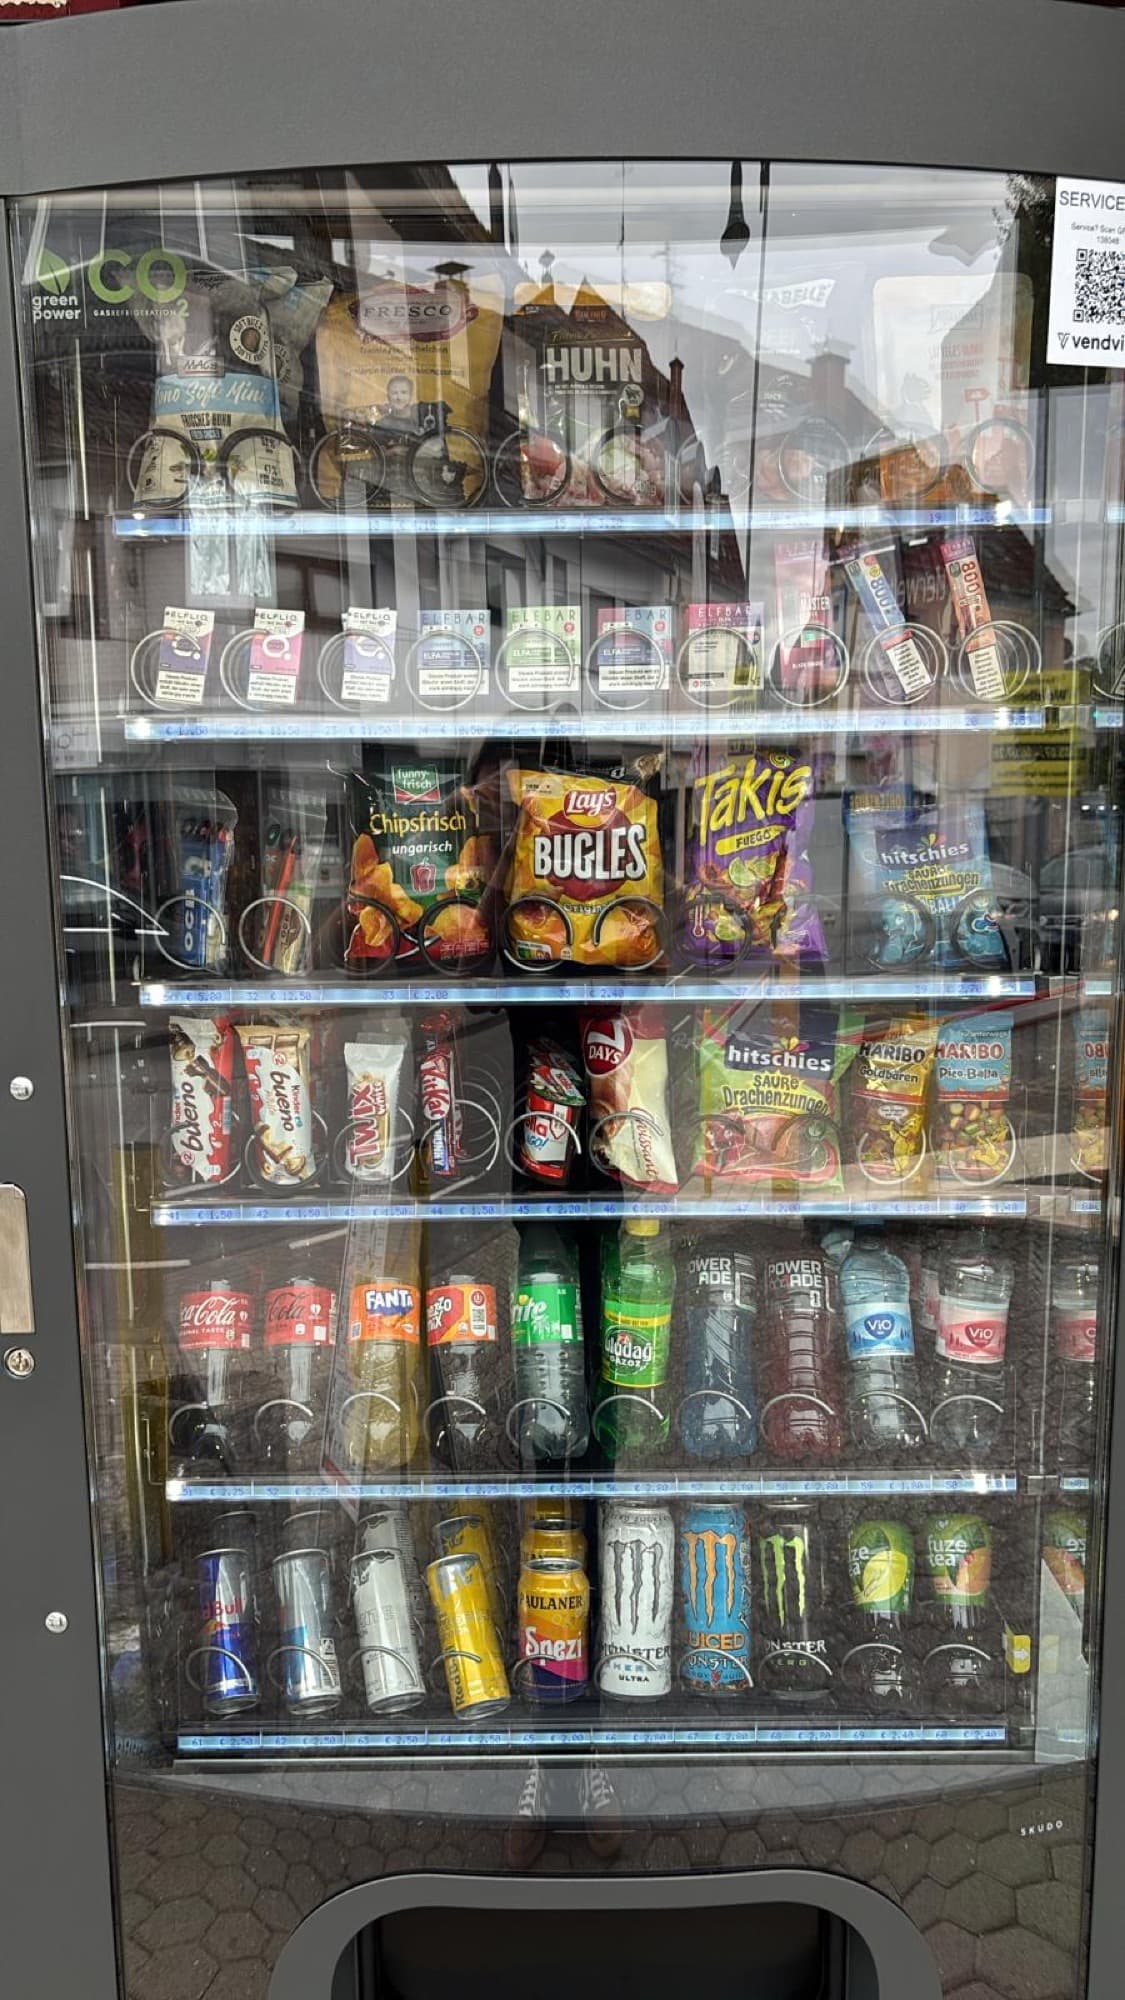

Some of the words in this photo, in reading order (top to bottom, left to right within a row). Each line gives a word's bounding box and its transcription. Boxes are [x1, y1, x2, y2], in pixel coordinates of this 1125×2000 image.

[1059, 190, 1125, 211] SERVICE
[32, 296, 78, 310] green
[364, 305, 451, 317] FRESCO
[33, 309, 81, 323] power
[547, 347, 642, 382] HUHN
[566, 788, 616, 817] Lay's
[695, 759, 812, 847] Takis
[369, 810, 467, 837] Chipsfrisch
[392, 840, 453, 857] ungarisch
[735, 829, 771, 849] FUEGO
[534, 824, 646, 880] BUGLES
[881, 842, 970, 865] hitschies
[588, 1044, 623, 1065] DAYS
[728, 1045, 832, 1072] hitschies
[859, 1041, 926, 1063] HARIBO
[934, 1043, 1004, 1059] HARIBO
[270, 1070, 295, 1132] bueno
[723, 1085, 829, 1115] Drachenzungen
[180, 1081, 204, 1151] bueno
[350, 1084, 380, 1168] TWIX
[689, 1257, 732, 1273] OWER
[768, 1259, 822, 1276] POWER
[698, 1271, 732, 1285] ADE
[790, 1273, 824, 1288] ADE
[928, 1534, 968, 1553] fuze
[928, 1553, 957, 1567] tea
[521, 1594, 583, 1610] AULANER
[525, 1625, 583, 1665] Spezi
[687, 1631, 745, 1650] UICED
[1020, 1819, 1064, 1837] SKUDO
